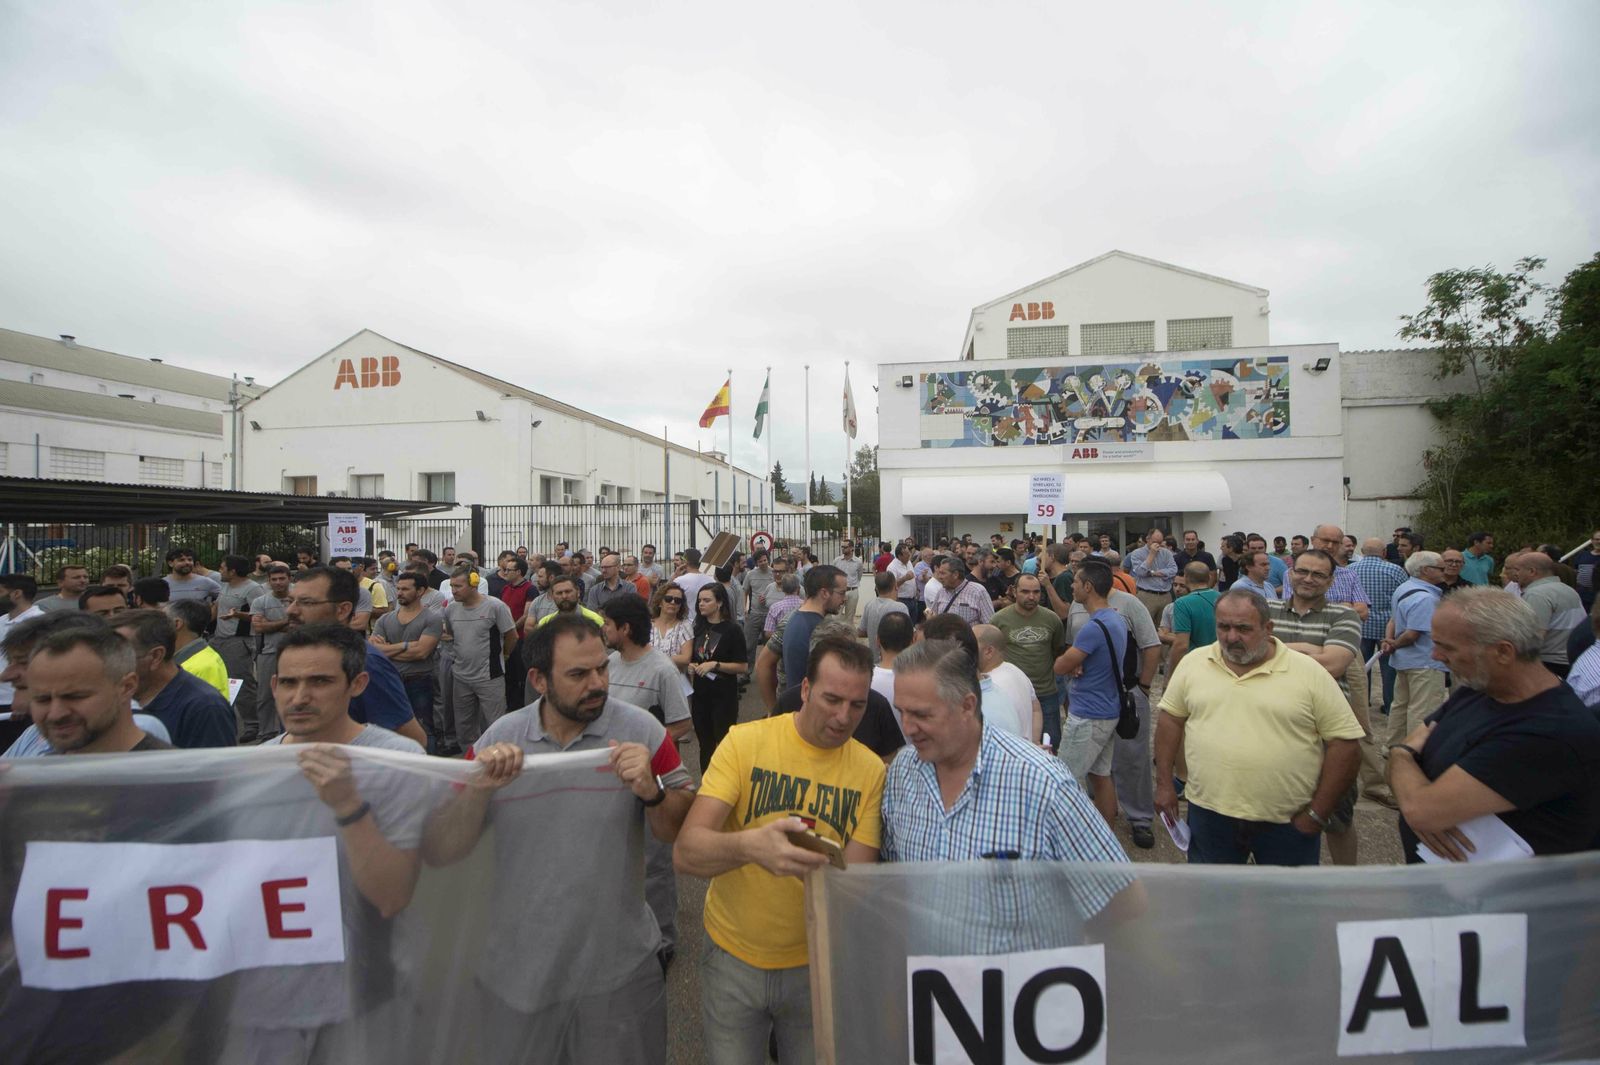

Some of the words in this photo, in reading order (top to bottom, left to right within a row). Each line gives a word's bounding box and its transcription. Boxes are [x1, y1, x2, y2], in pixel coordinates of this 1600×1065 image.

[1009, 301, 1056, 321] ABB
[334, 356, 402, 390] ABB
[1072, 448, 1099, 459] ABB
[1037, 504, 1055, 517] 59
[337, 526, 357, 534] ABB
[342, 536, 353, 544] 59
[744, 766, 811, 826] TOMMY
[808, 783, 862, 848] JEANS
[45, 877, 313, 960] ERE
[911, 966, 1104, 1065] NO
[1346, 931, 1509, 1034] AL
